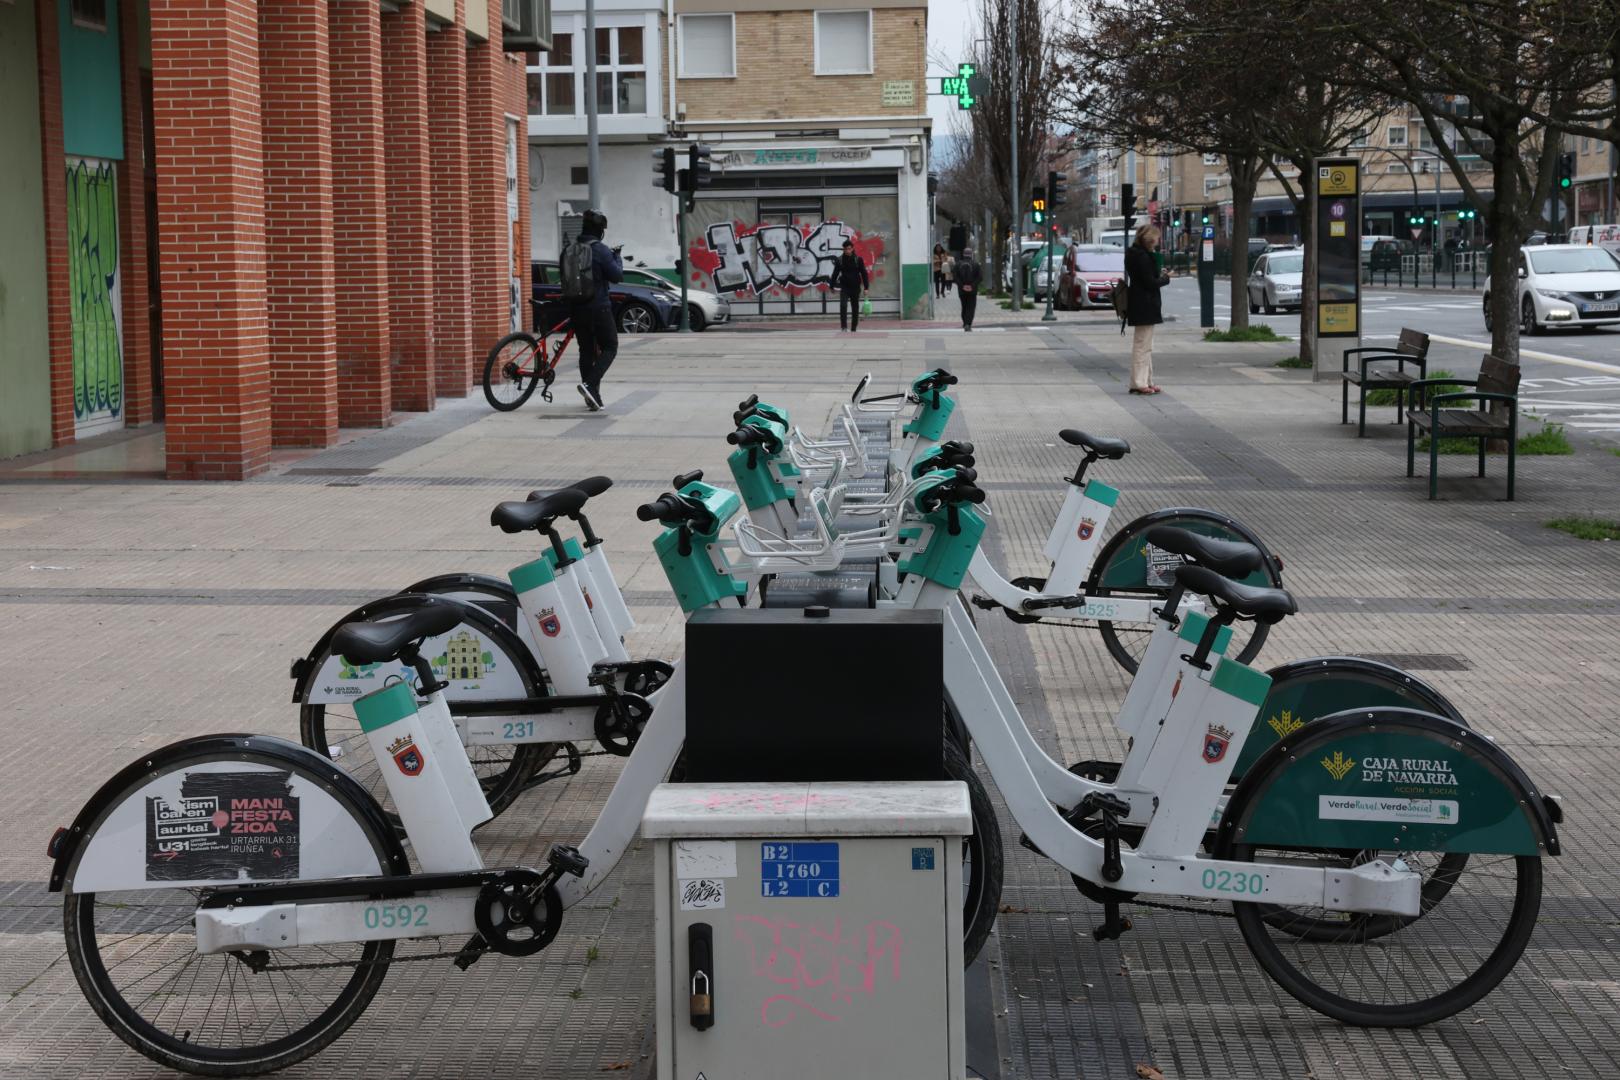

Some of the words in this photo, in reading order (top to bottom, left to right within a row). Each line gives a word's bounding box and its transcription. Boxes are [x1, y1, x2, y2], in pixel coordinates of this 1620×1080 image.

[1333, 205, 1343, 216] 10
[1205, 227, 1213, 238] P
[503, 721, 534, 739] 231
[1362, 757, 1399, 770] CAJA
[1402, 759, 1452, 772] RURAL
[1362, 770, 1383, 782] DE
[1388, 772, 1459, 785] NAVARRA
[231, 798, 283, 809] MANI
[231, 810, 294, 821] FESTA
[160, 823, 209, 834] aurka!
[231, 821, 278, 833] ZIOA
[158, 840, 190, 852] U31
[231, 835, 284, 845] URTARRILAK
[286, 835, 297, 844] 31
[777, 863, 821, 878] 1760
[1202, 869, 1263, 894] 0230
[364, 904, 429, 929] 0592
